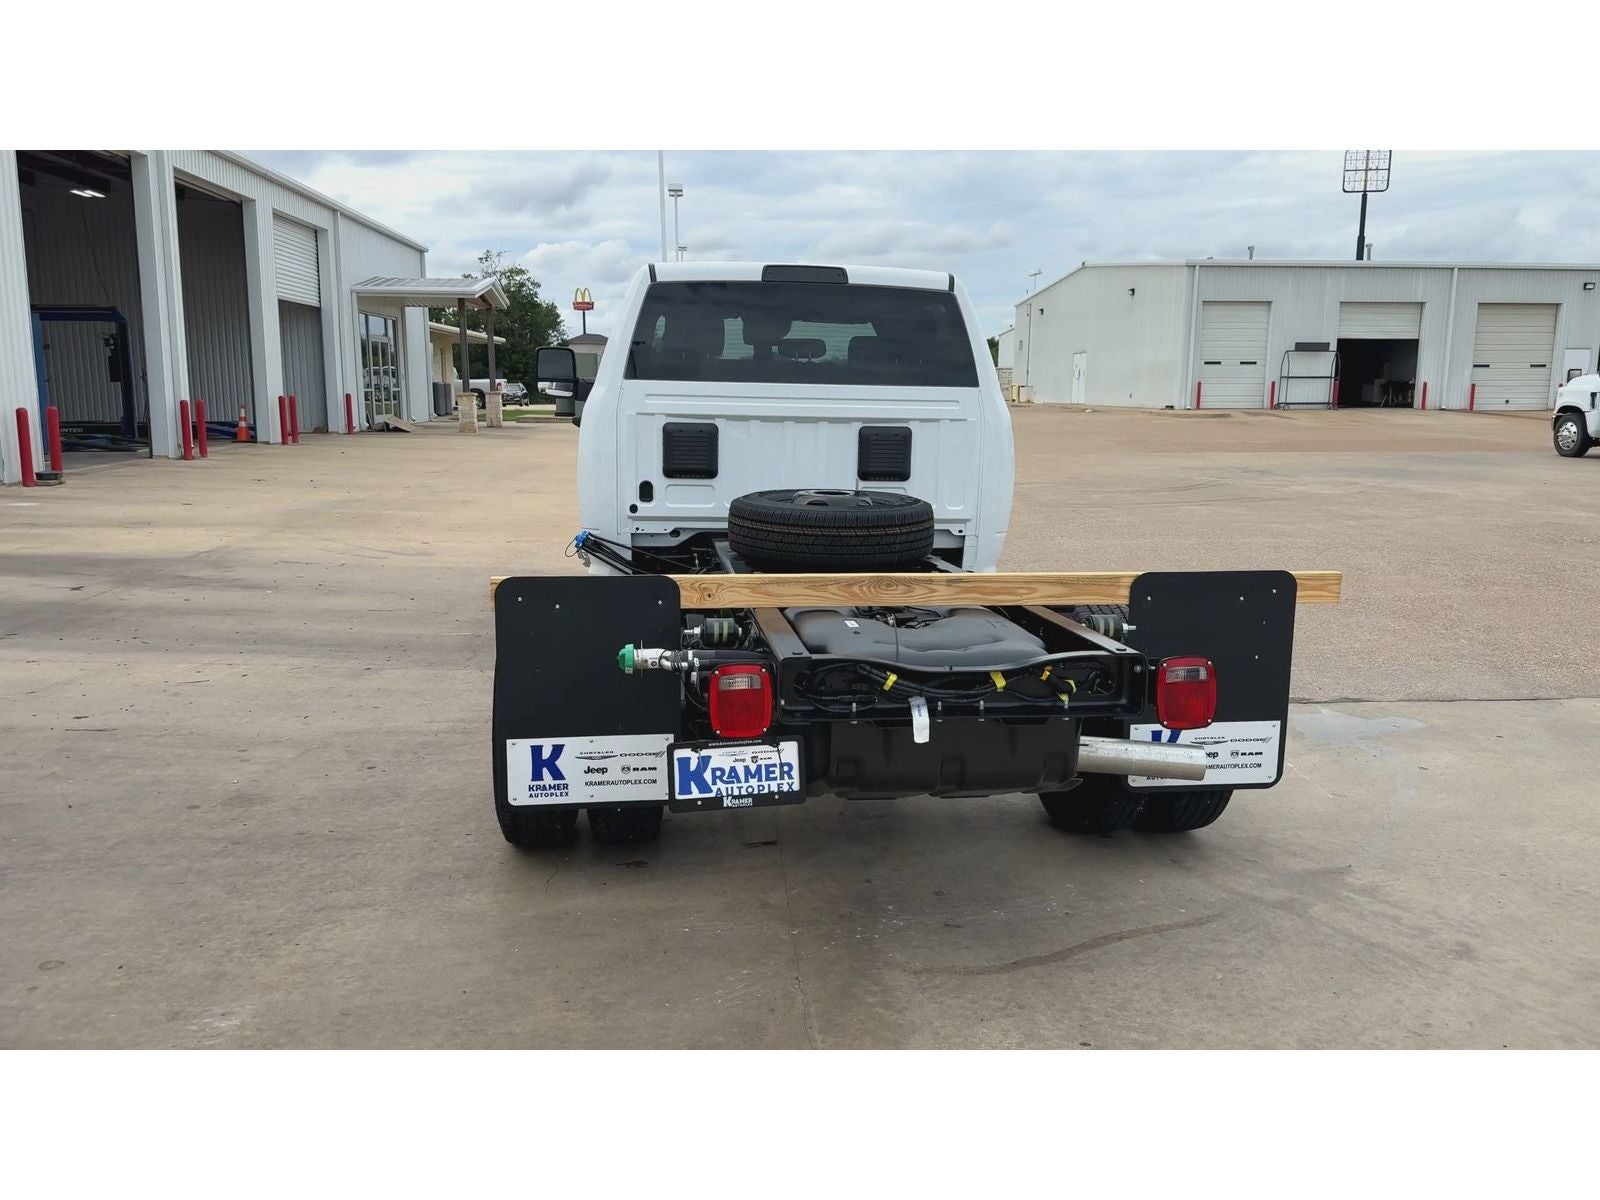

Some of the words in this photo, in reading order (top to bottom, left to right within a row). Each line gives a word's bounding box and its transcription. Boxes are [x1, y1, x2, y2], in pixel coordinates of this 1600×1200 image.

[530, 744, 566, 781] K
[583, 765, 608, 775] Jeep
[676, 754, 795, 796] KRAMER
[528, 783, 569, 792] KRAMER
[584, 778, 657, 787] KRAMERAUTOPLEX.COM
[715, 782, 795, 798] AUTOPLEX
